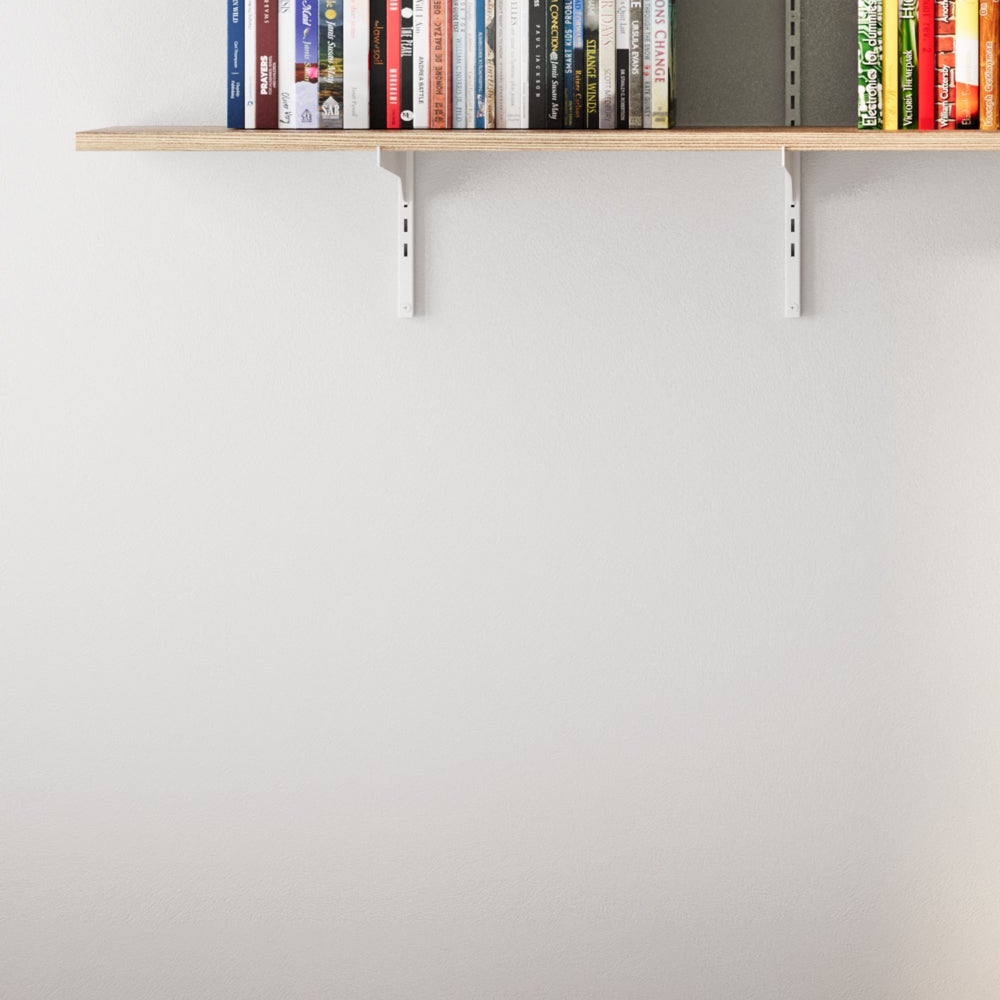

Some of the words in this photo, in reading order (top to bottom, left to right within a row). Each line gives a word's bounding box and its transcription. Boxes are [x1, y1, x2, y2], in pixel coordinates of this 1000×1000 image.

[302, 0, 312, 26] Maid
[980, 3, 988, 16] On
[324, 20, 336, 40] Janis
[374, 26, 384, 42] law
[401, 26, 412, 38] THE
[550, 5, 559, 52] CONNECTION
[600, 14, 614, 46] DAYS
[862, 0, 878, 46] dummies
[922, 22, 930, 40] rev.
[400, 40, 412, 58] PEARL
[434, 24, 442, 50] BALZAC
[303, 42, 312, 60] Janis
[326, 42, 336, 64] Susan
[374, 48, 384, 64] soil
[435, 54, 442, 62] DE
[587, 40, 596, 78] STRANGE
[654, 30, 667, 84] CHANGE
[862, 52, 878, 65] for
[260, 56, 268, 95] PRAYERS
[325, 66, 336, 84] May
[902, 50, 914, 92] THEMEPARK
[390, 68, 398, 104] MURAKAMI
[587, 82, 596, 114] WINDS
[862, 69, 878, 126] Electronics
[550, 103, 558, 120] May
[902, 94, 912, 126] VICTORIA
[940, 100, 949, 128] William
